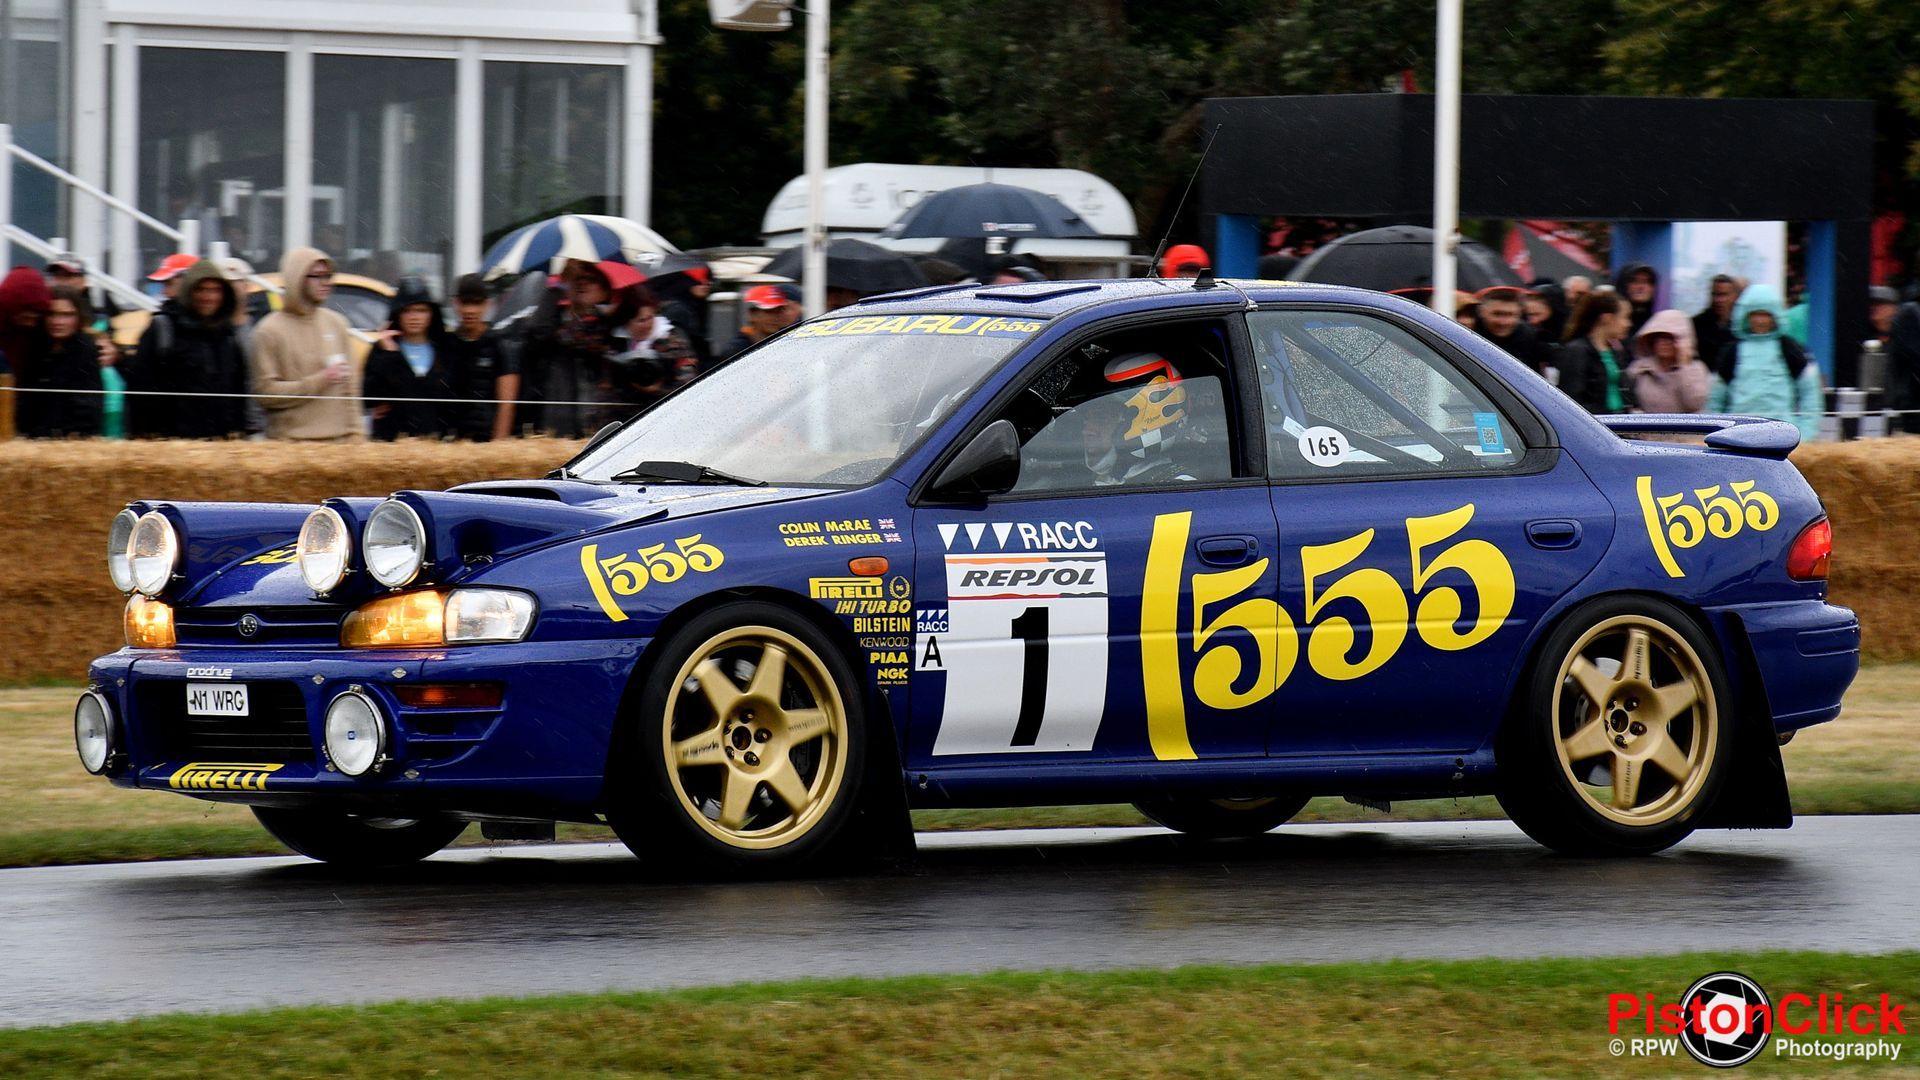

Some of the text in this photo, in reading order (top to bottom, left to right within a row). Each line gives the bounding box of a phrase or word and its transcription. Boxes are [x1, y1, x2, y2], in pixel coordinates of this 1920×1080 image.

[797, 315, 986, 337] SUBARU
[1308, 436, 1340, 457] 165
[778, 519, 872, 535] COLIN McRAE
[1017, 521, 1098, 550] RACC
[784, 533, 884, 548] DEREK RINGER
[960, 568, 1096, 587] REPSOL
[808, 576, 884, 599] PIRELLI
[835, 600, 912, 614] IHI TURBO
[854, 617, 911, 633] BILSTEIN
[917, 620, 948, 632] RACC
[859, 636, 910, 648] KENWOOD
[921, 635, 943, 668] A
[870, 652, 909, 664] PIAA
[877, 668, 909, 680] NGK
[1010, 606, 1049, 746] 1
[193, 690, 244, 712] N1 WRG
[169, 762, 285, 791] PIRELLI
